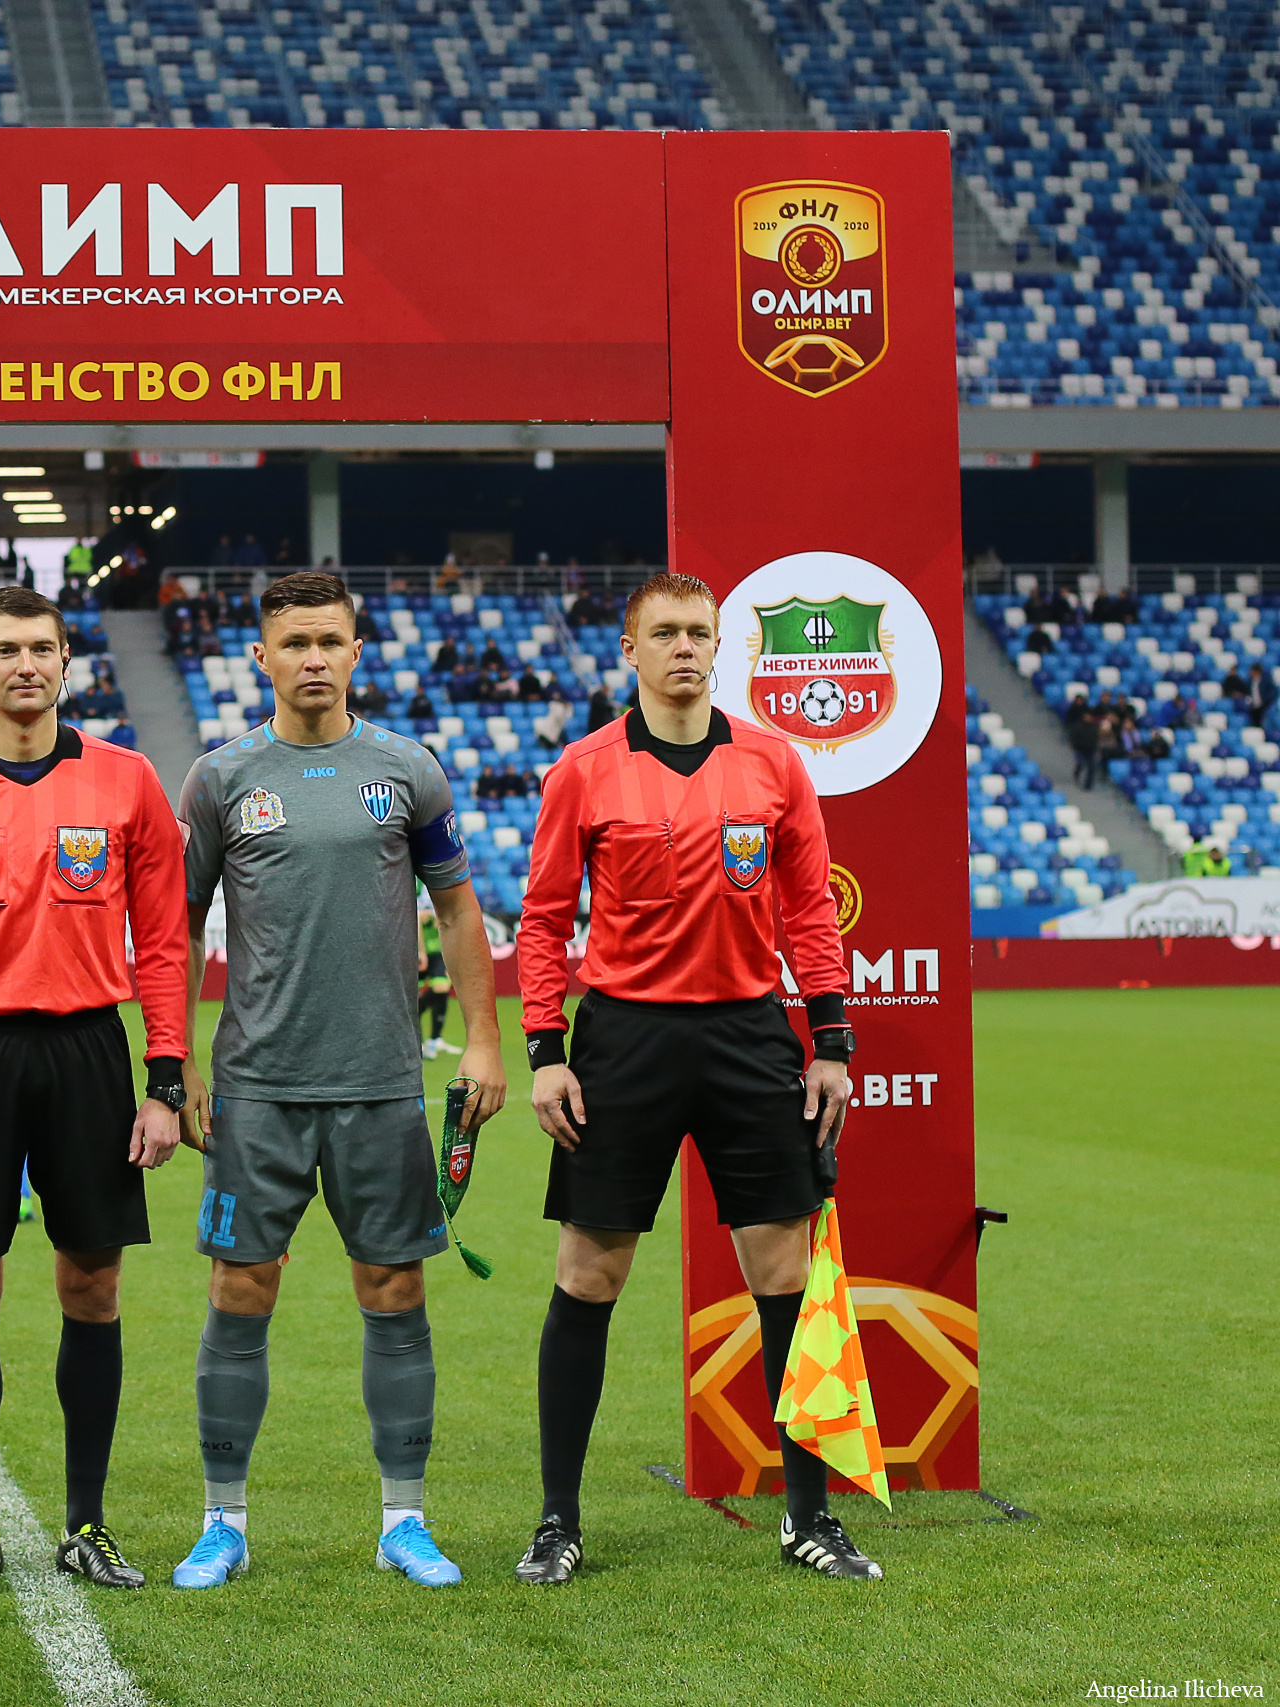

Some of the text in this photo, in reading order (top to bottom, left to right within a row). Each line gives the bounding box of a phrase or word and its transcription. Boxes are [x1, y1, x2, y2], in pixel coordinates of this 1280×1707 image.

[778, 199, 839, 222] ФНЛ
[753, 222, 869, 231] 2019 2020
[193, 286, 344, 305] КОНТОРА
[751, 289, 872, 315] ОЛИМП
[774, 317, 852, 330] OLIMP.BET
[222, 361, 343, 402] ФНЛ
[762, 657, 880, 672] НЕФТЕХИМИК
[301, 766, 337, 779] JAKO
[872, 995, 940, 1007] КОНТОРА
[197, 1188, 237, 1248] 41
